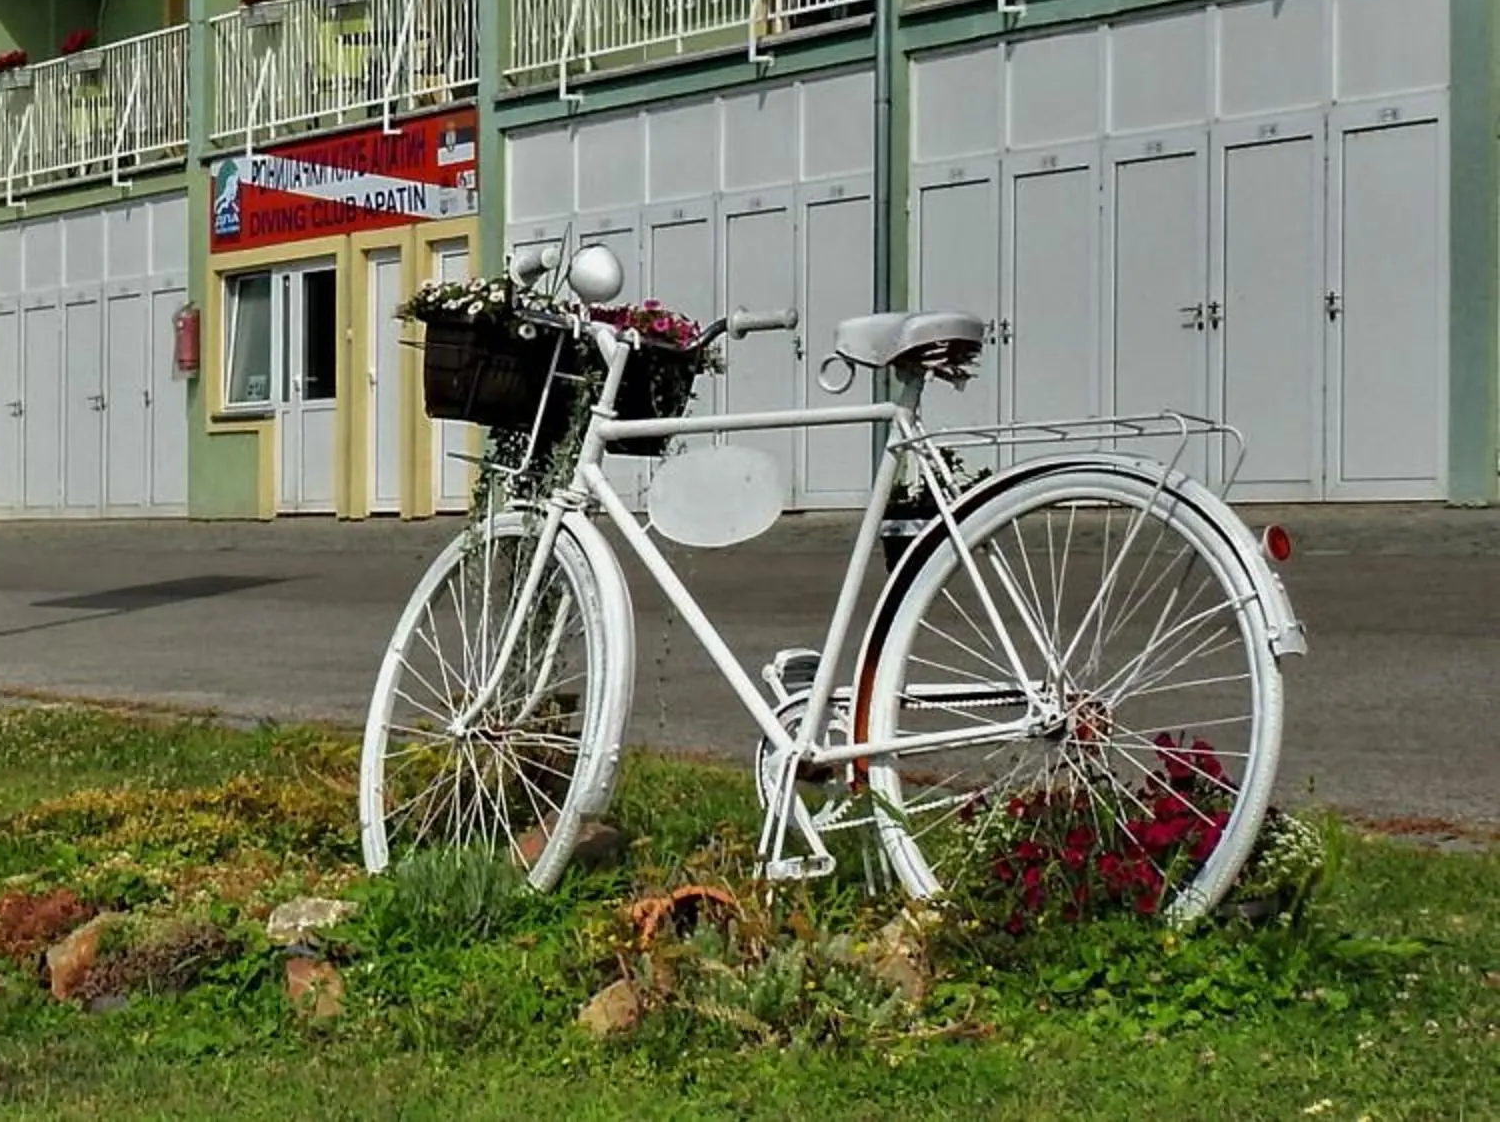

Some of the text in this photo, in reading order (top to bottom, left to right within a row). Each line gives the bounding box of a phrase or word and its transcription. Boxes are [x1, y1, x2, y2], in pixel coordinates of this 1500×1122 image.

[250, 183, 426, 237] DIVING CLUB APATIN
